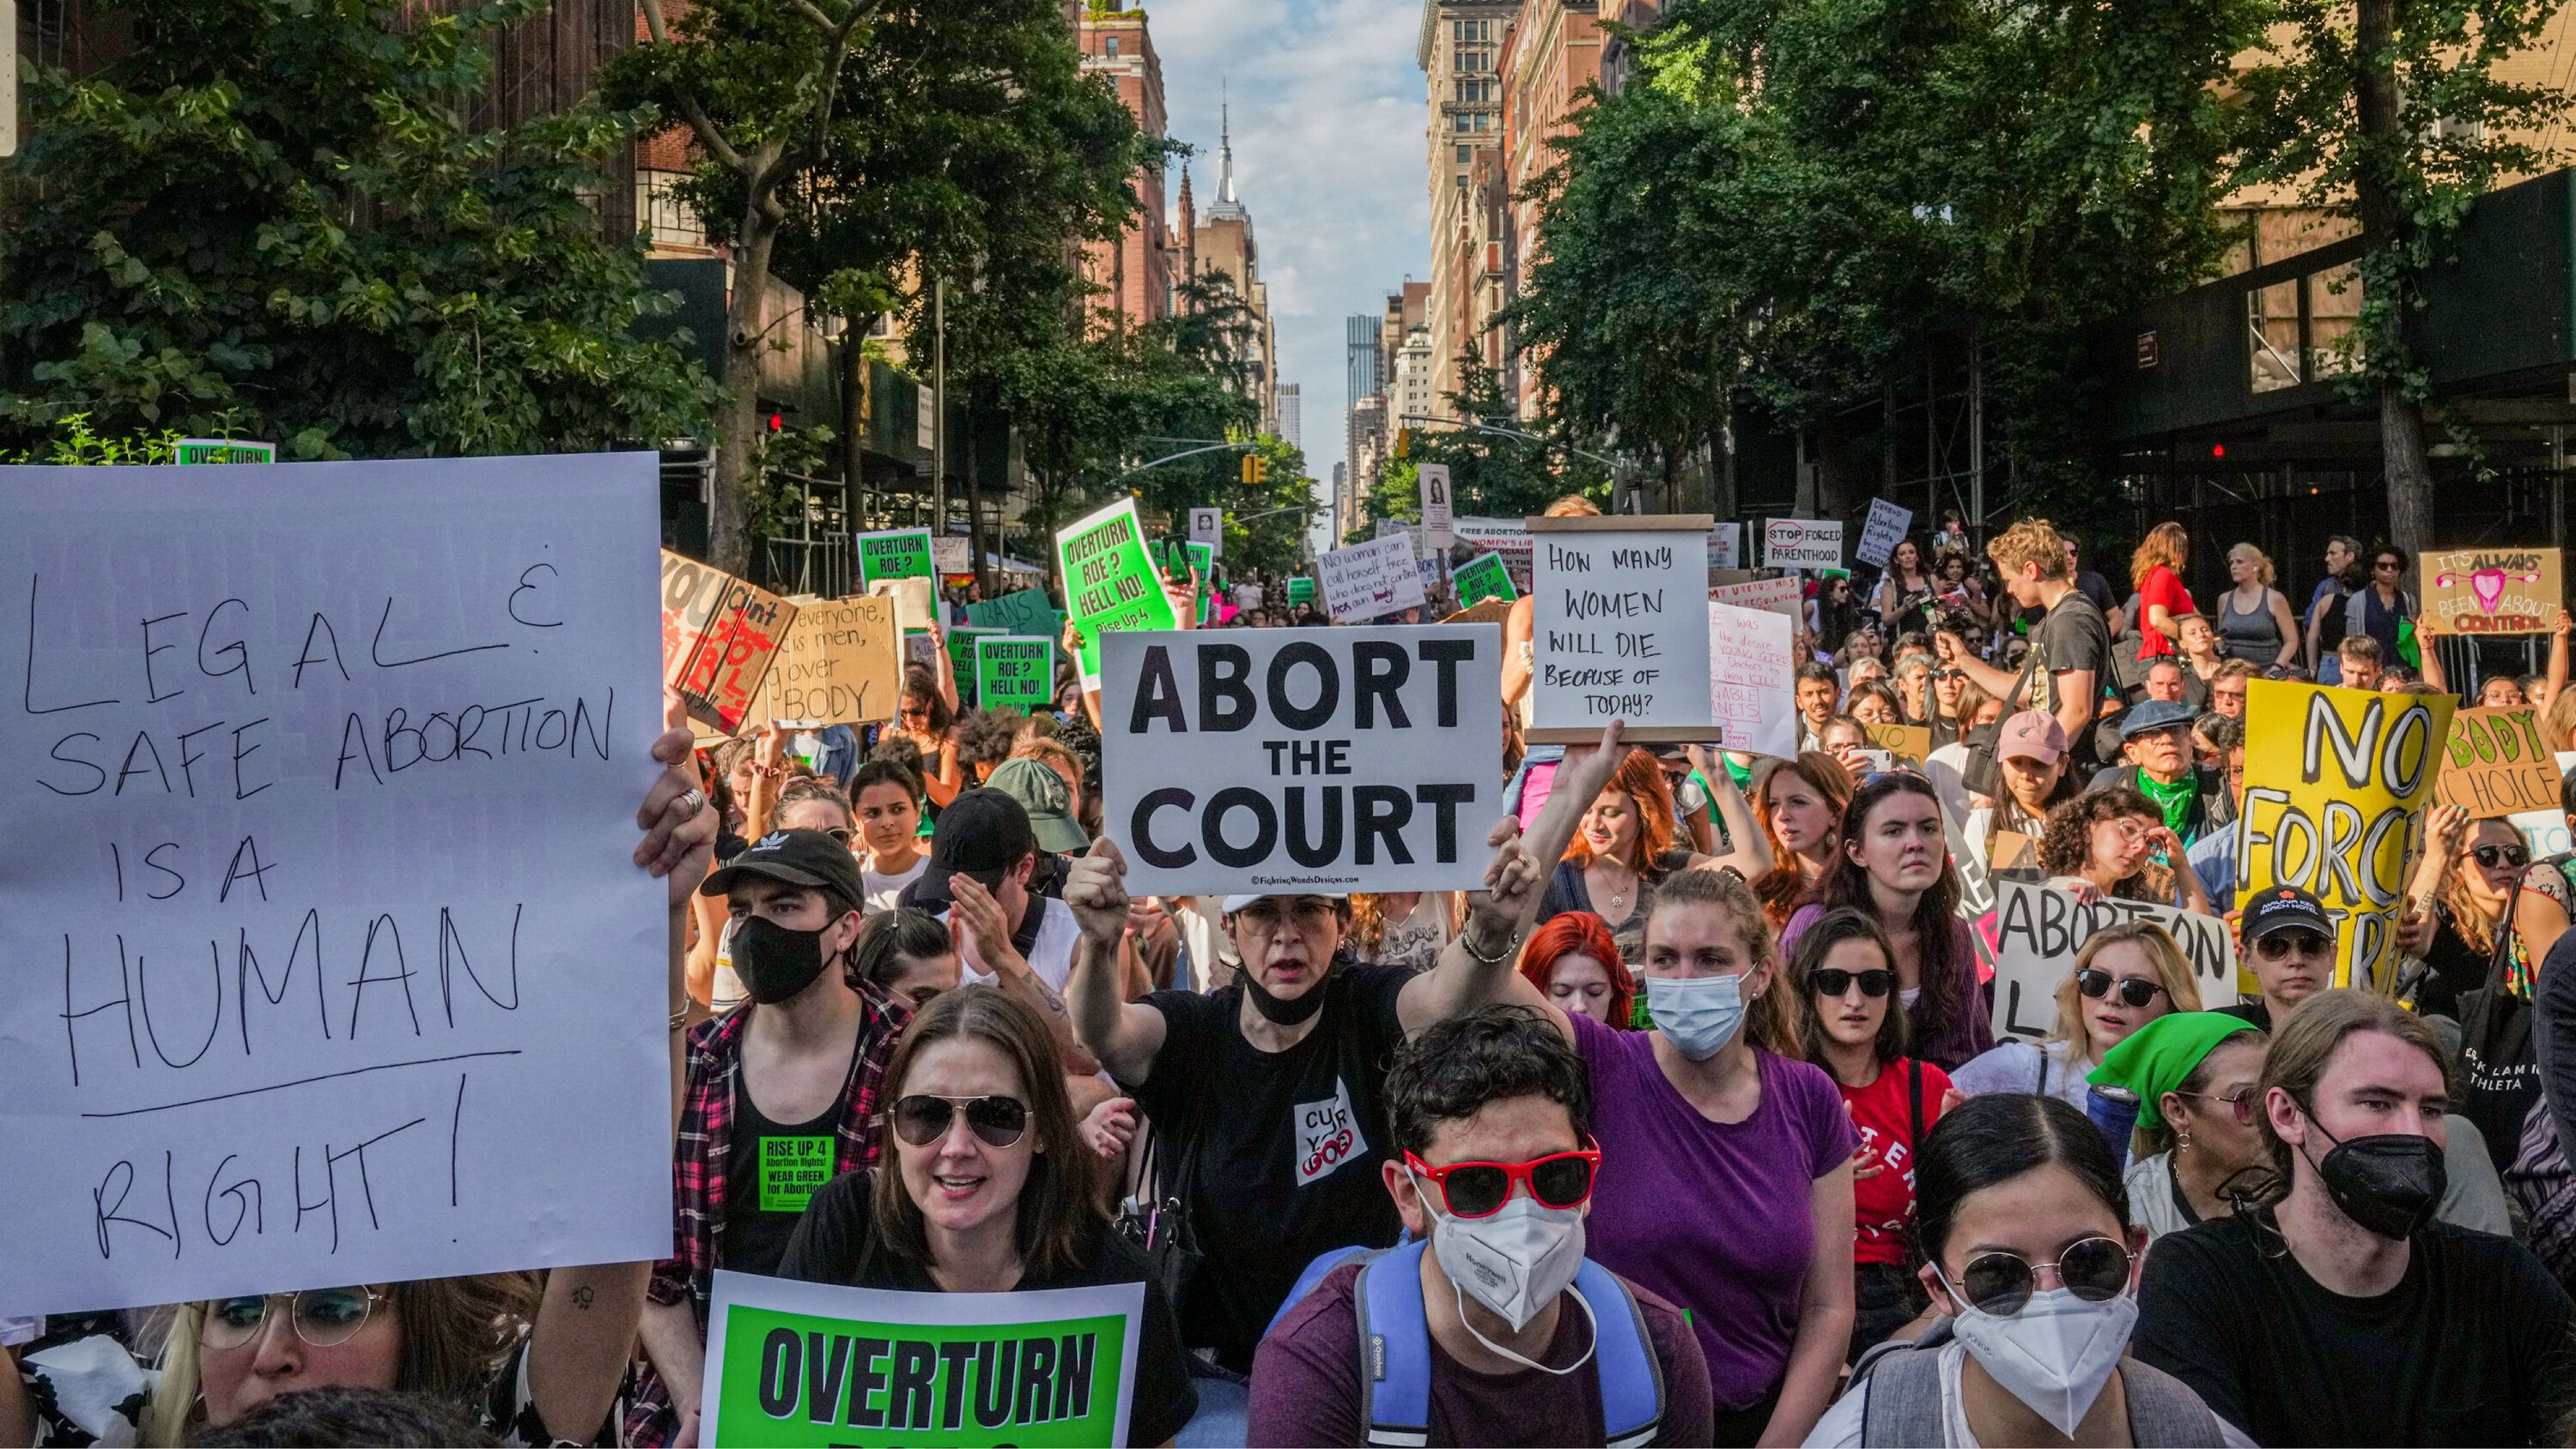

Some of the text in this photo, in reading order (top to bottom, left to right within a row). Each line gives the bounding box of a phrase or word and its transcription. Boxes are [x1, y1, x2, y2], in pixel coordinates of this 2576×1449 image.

[190, 447, 264, 464] OVETURN
[866, 537, 923, 556] OVERTURN
[1067, 518, 1132, 566] OVERTURN
[1769, 530, 1842, 542] STOP FORCED
[880, 558, 901, 573] ROE
[1322, 541, 1405, 569] No woman can
[1549, 543, 1672, 573] HOW MANY
[1771, 549, 1838, 561] PARENTHOOD
[2436, 551, 2543, 573] IT'S ALWAYS
[1082, 556, 1110, 588] ROE
[1327, 570, 1344, 587] call
[1456, 558, 1498, 584] OVERTURN
[1078, 573, 1147, 618] HELL NO!
[1329, 588, 1349, 602] who
[1374, 573, 1388, 587] not
[1468, 577, 1485, 591] ROE
[1732, 584, 1771, 596] UTERUS
[981, 592, 1033, 627] BANS
[1352, 597, 1370, 608] own
[1565, 588, 1662, 620] WOMEN
[2439, 594, 2556, 617] BEEN ABOUT
[798, 604, 885, 628] everyone,
[1121, 611, 1139, 629] Up
[1139, 608, 1150, 621] 4
[1737, 618, 1759, 630] was
[2454, 614, 2547, 633] CONTROL
[26, 573, 509, 713] LEGAL
[816, 629, 866, 646] men,
[1549, 629, 1662, 658] WILL DIE
[985, 644, 1044, 659] OVERTURN
[788, 658, 841, 682] over
[999, 662, 1019, 676] ROE
[1545, 664, 1661, 687] BECAUSE OF
[991, 680, 1016, 694] HELL
[1020, 680, 1041, 694] NO!
[1129, 640, 1474, 734] ABORT
[785, 680, 869, 720] BODY
[1584, 694, 1654, 717] TODAY?
[36, 688, 613, 799] SAFE ABORTION
[2301, 690, 2432, 799] NO
[2446, 710, 2545, 769] BODY
[1262, 740, 1352, 776] THE
[2443, 767, 2561, 813] CHOICE
[1131, 784, 1475, 870] COURT
[112, 835, 277, 903] IS A
[2259, 904, 2318, 916] BEACH HOTEL
[2262, 900, 2316, 909] MAUNA KEA
[1997, 887, 2227, 980] ABORTON
[59, 903, 522, 1087] HUMAN
[767, 1141, 826, 1156] RISE UP 4
[766, 1157, 827, 1168] Abortion Rights!
[769, 1171, 824, 1182] WEAR GREEN
[767, 1183, 781, 1195] for
[1467, 1252, 1506, 1284] Honeywell
[758, 1327, 1098, 1433] OVERTURN
